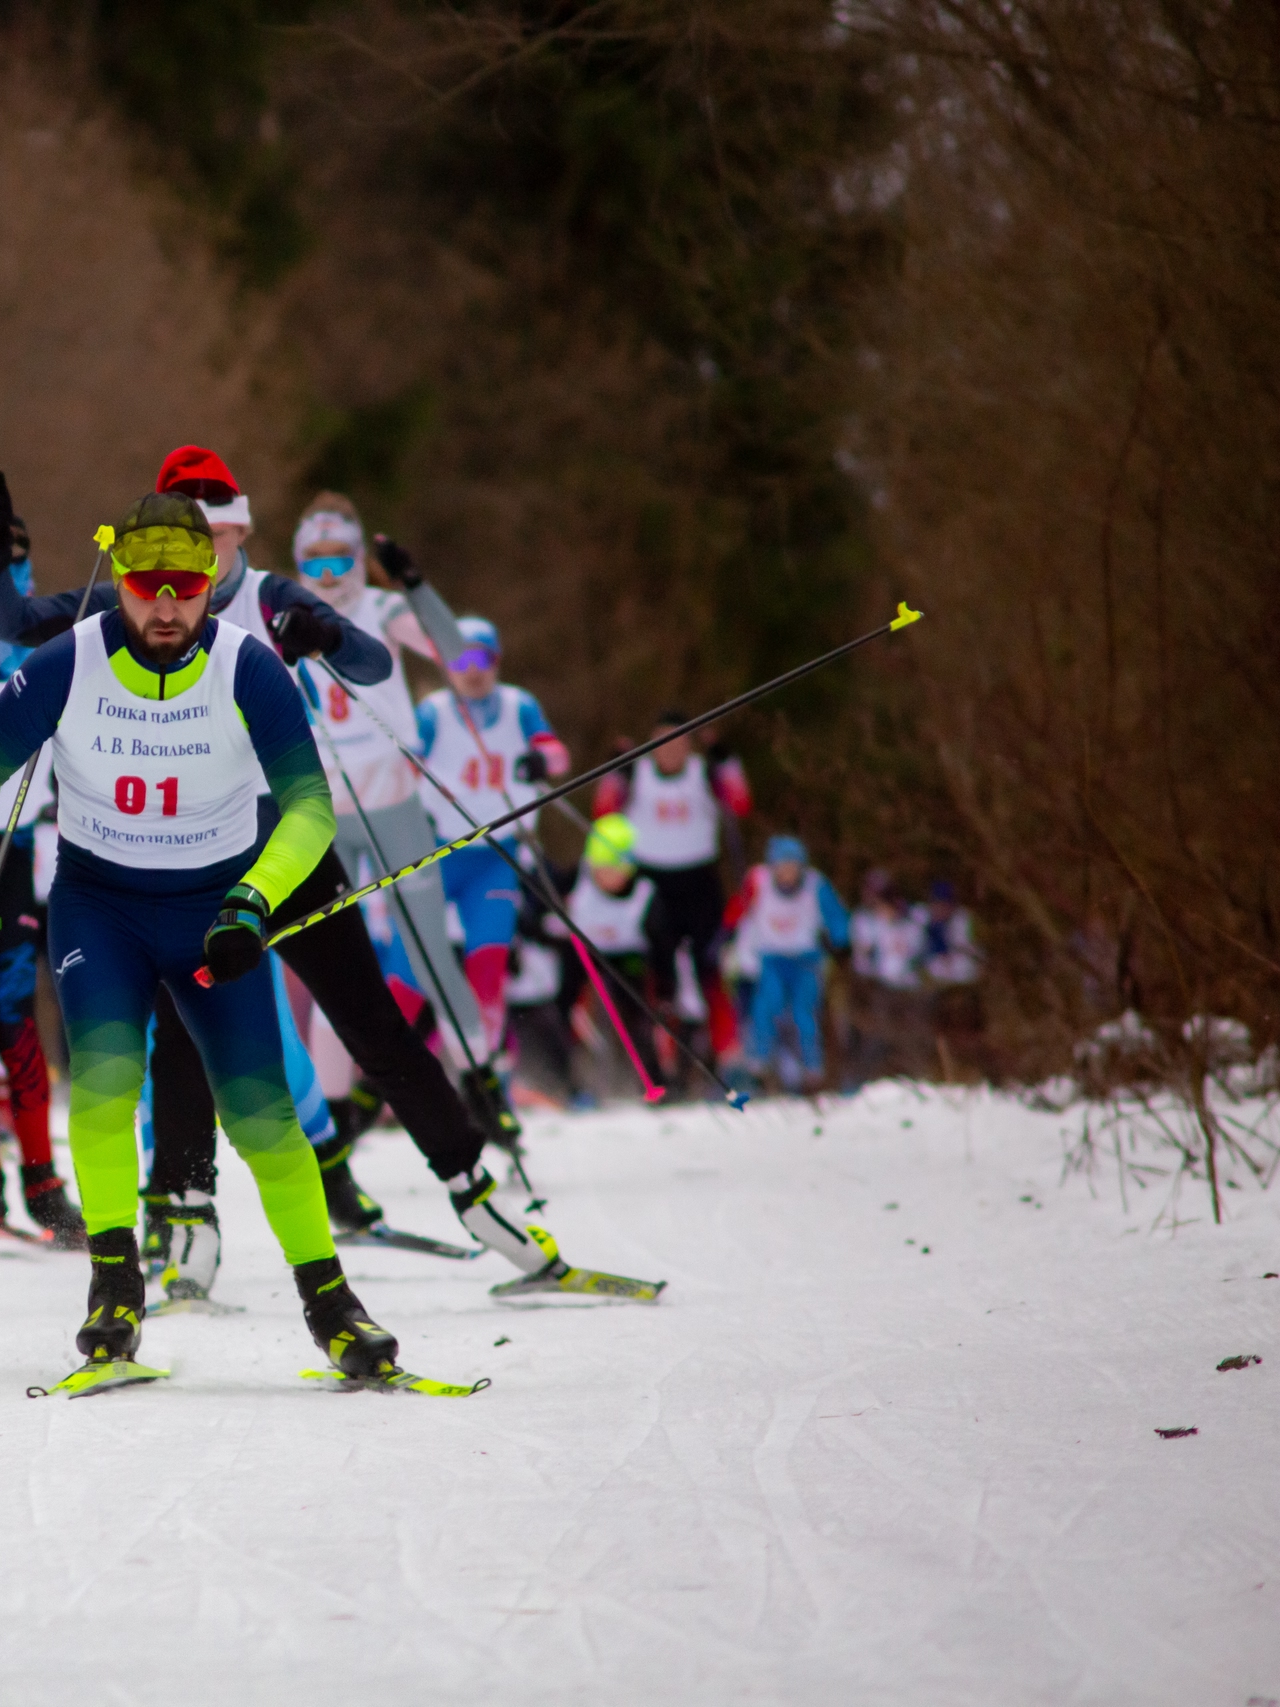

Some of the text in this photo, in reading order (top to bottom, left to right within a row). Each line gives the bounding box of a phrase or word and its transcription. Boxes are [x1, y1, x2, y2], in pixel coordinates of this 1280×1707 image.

[95, 696, 209, 724] Гонка памяти
[90, 735, 212, 757] А. В. Васильева
[114, 775, 179, 817] 01
[92, 817, 218, 844] Краснознаменск
